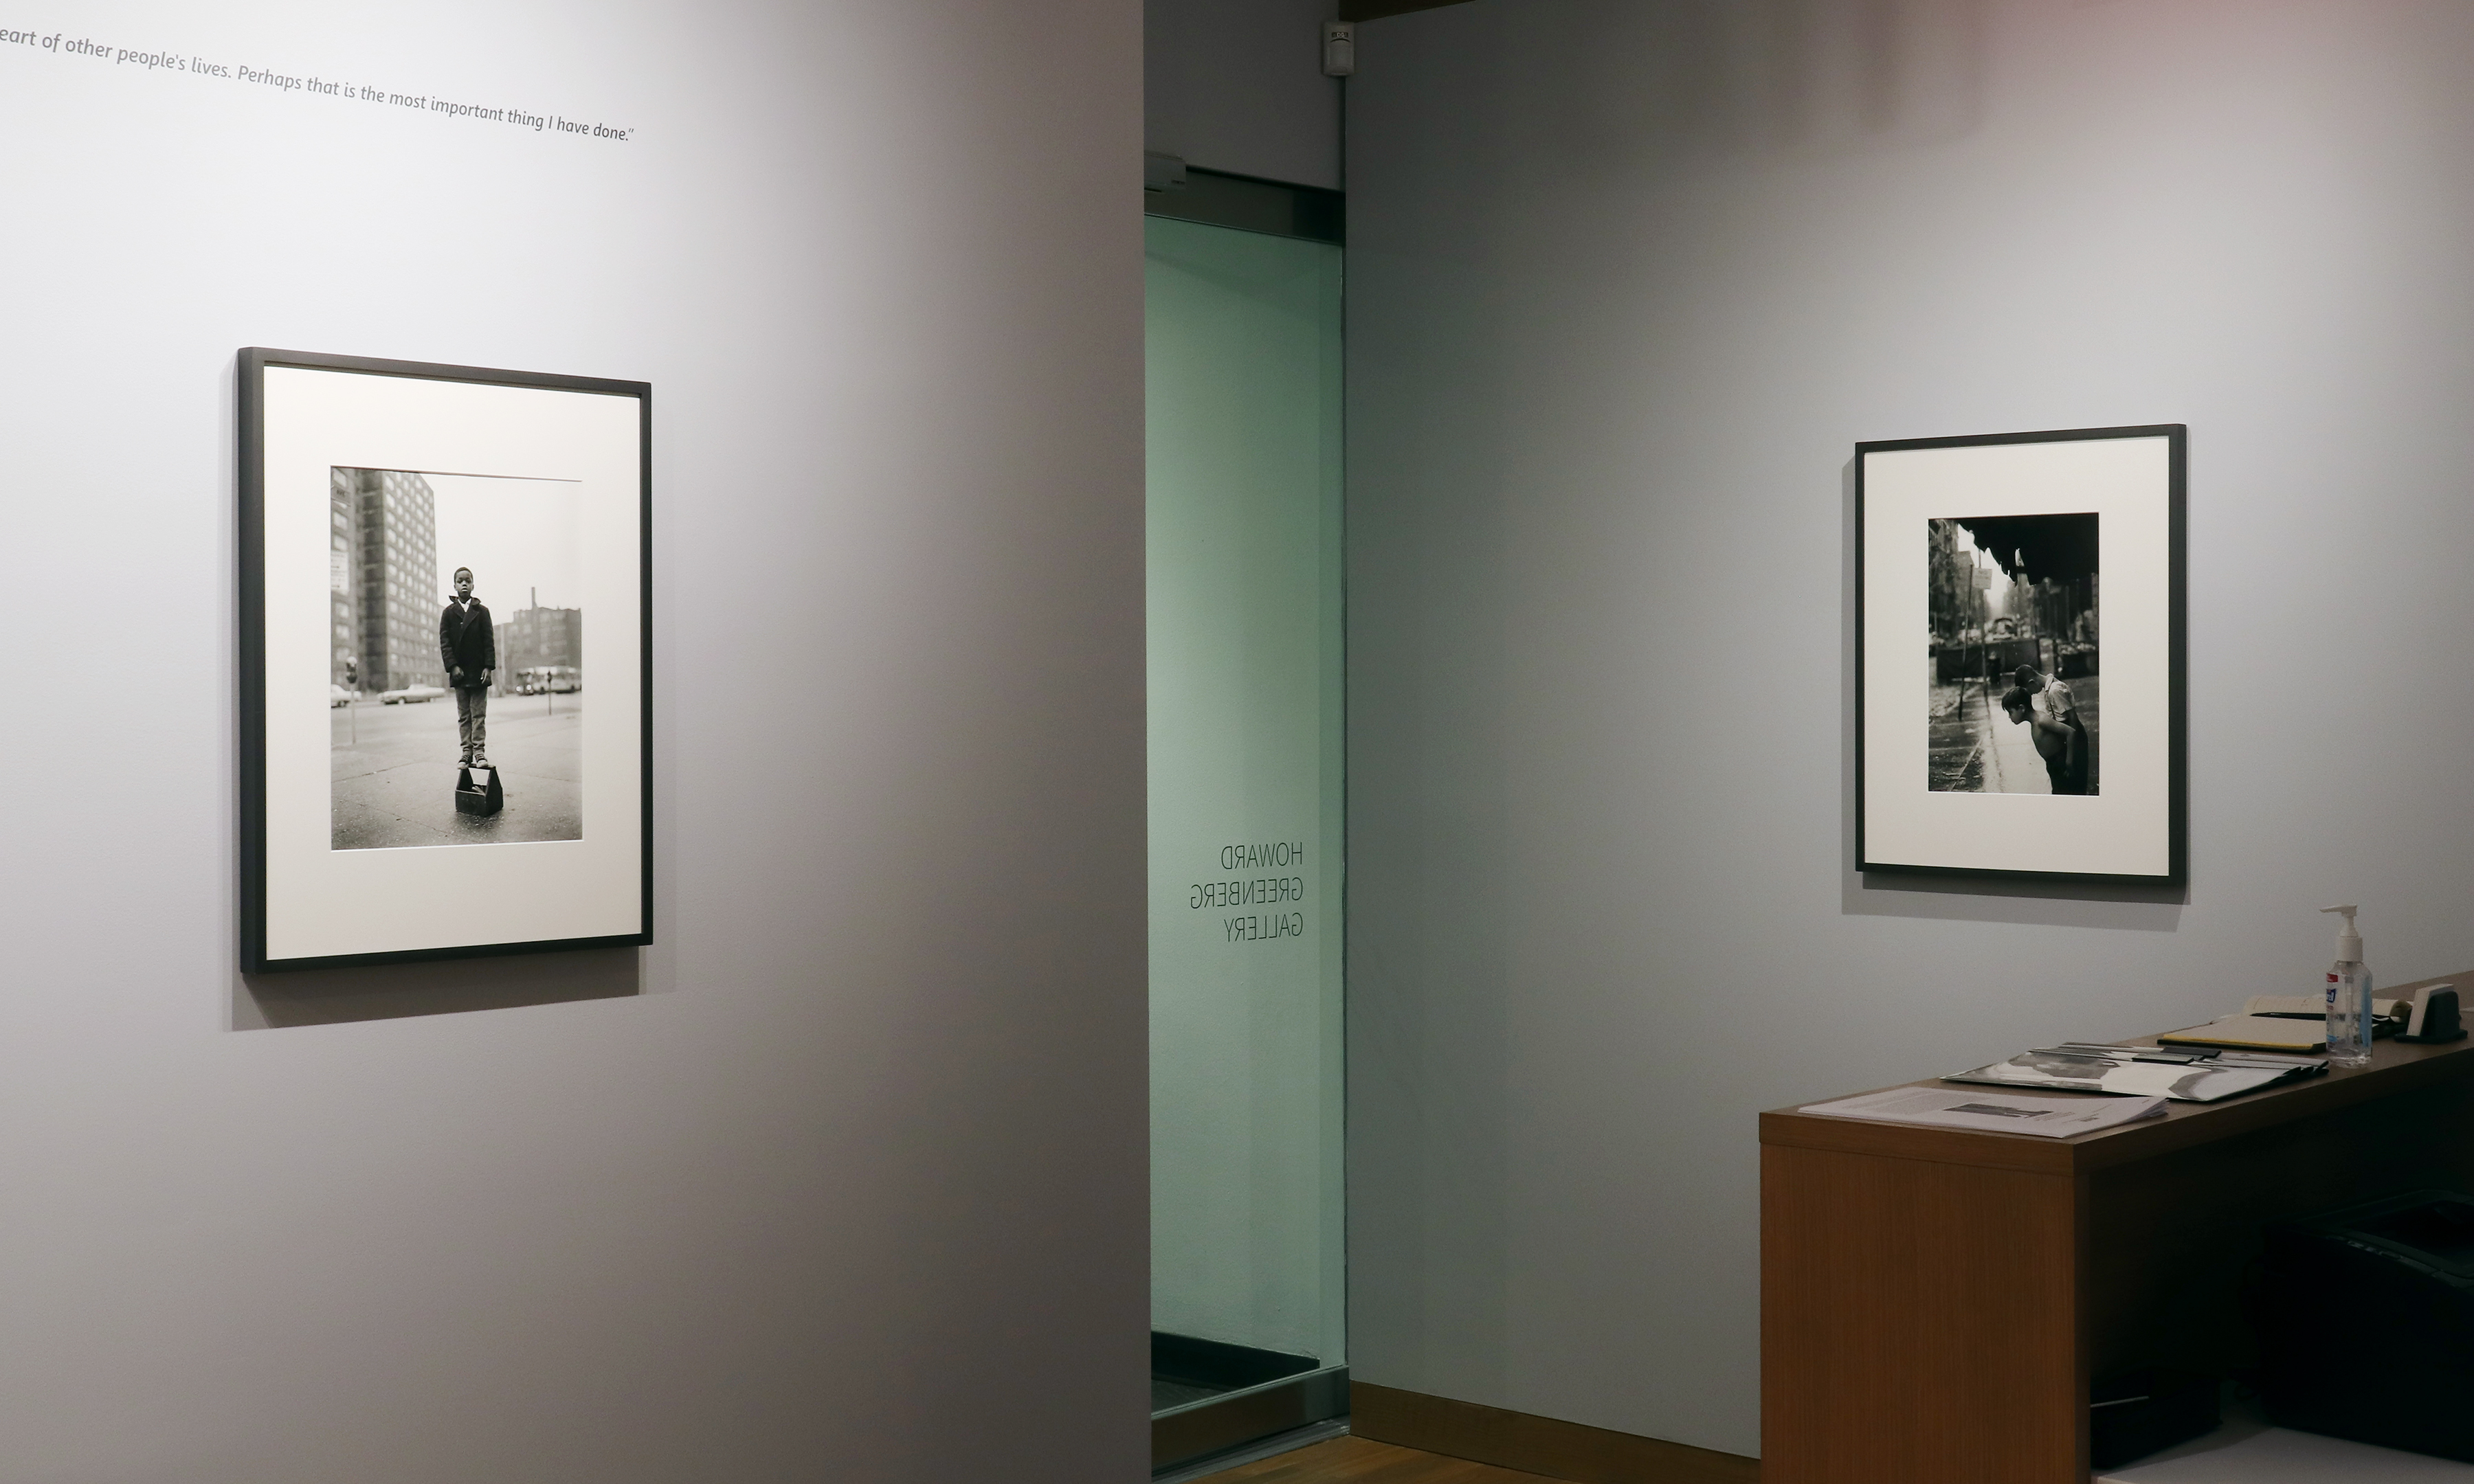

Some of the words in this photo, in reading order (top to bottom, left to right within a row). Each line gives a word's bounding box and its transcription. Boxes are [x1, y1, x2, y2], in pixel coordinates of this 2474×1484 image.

[43, 33, 63, 54] of
[65, 39, 113, 58] other
[117, 48, 186, 71] people's
[191, 56, 232, 78] lives.
[238, 65, 302, 92] Perhaps
[307, 78, 340, 96] that
[344, 82, 356, 98] is
[361, 85, 385, 103] the
[390, 93, 427, 109] most
[431, 95, 504, 122] important
[508, 109, 544, 132] thing
[548, 115, 553, 129] I
[557, 115, 590, 135] have
